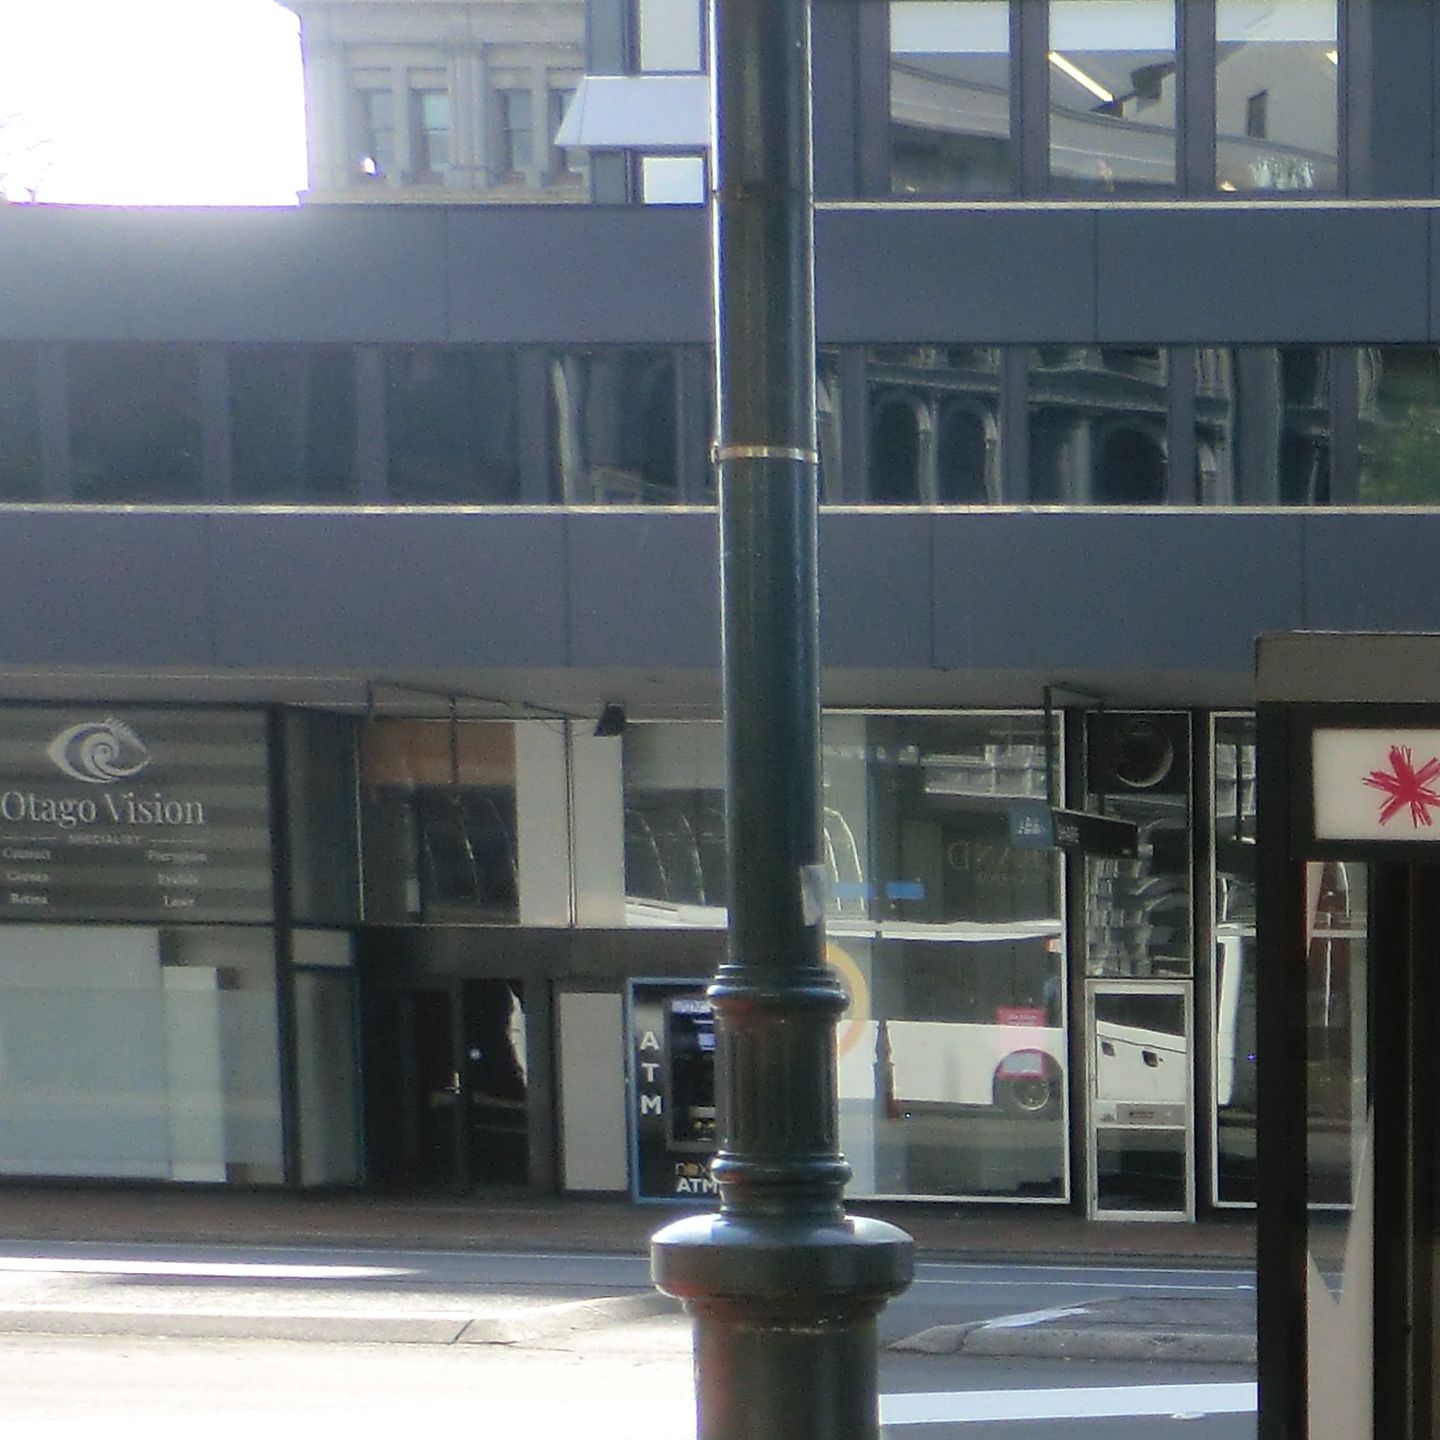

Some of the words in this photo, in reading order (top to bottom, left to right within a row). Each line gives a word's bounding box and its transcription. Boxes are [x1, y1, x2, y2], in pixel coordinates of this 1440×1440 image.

[1, 791, 98, 830] Otago
[103, 791, 206, 825] Vision
[639, 1031, 663, 1115] ATM
[676, 1178, 719, 1194] ATM
